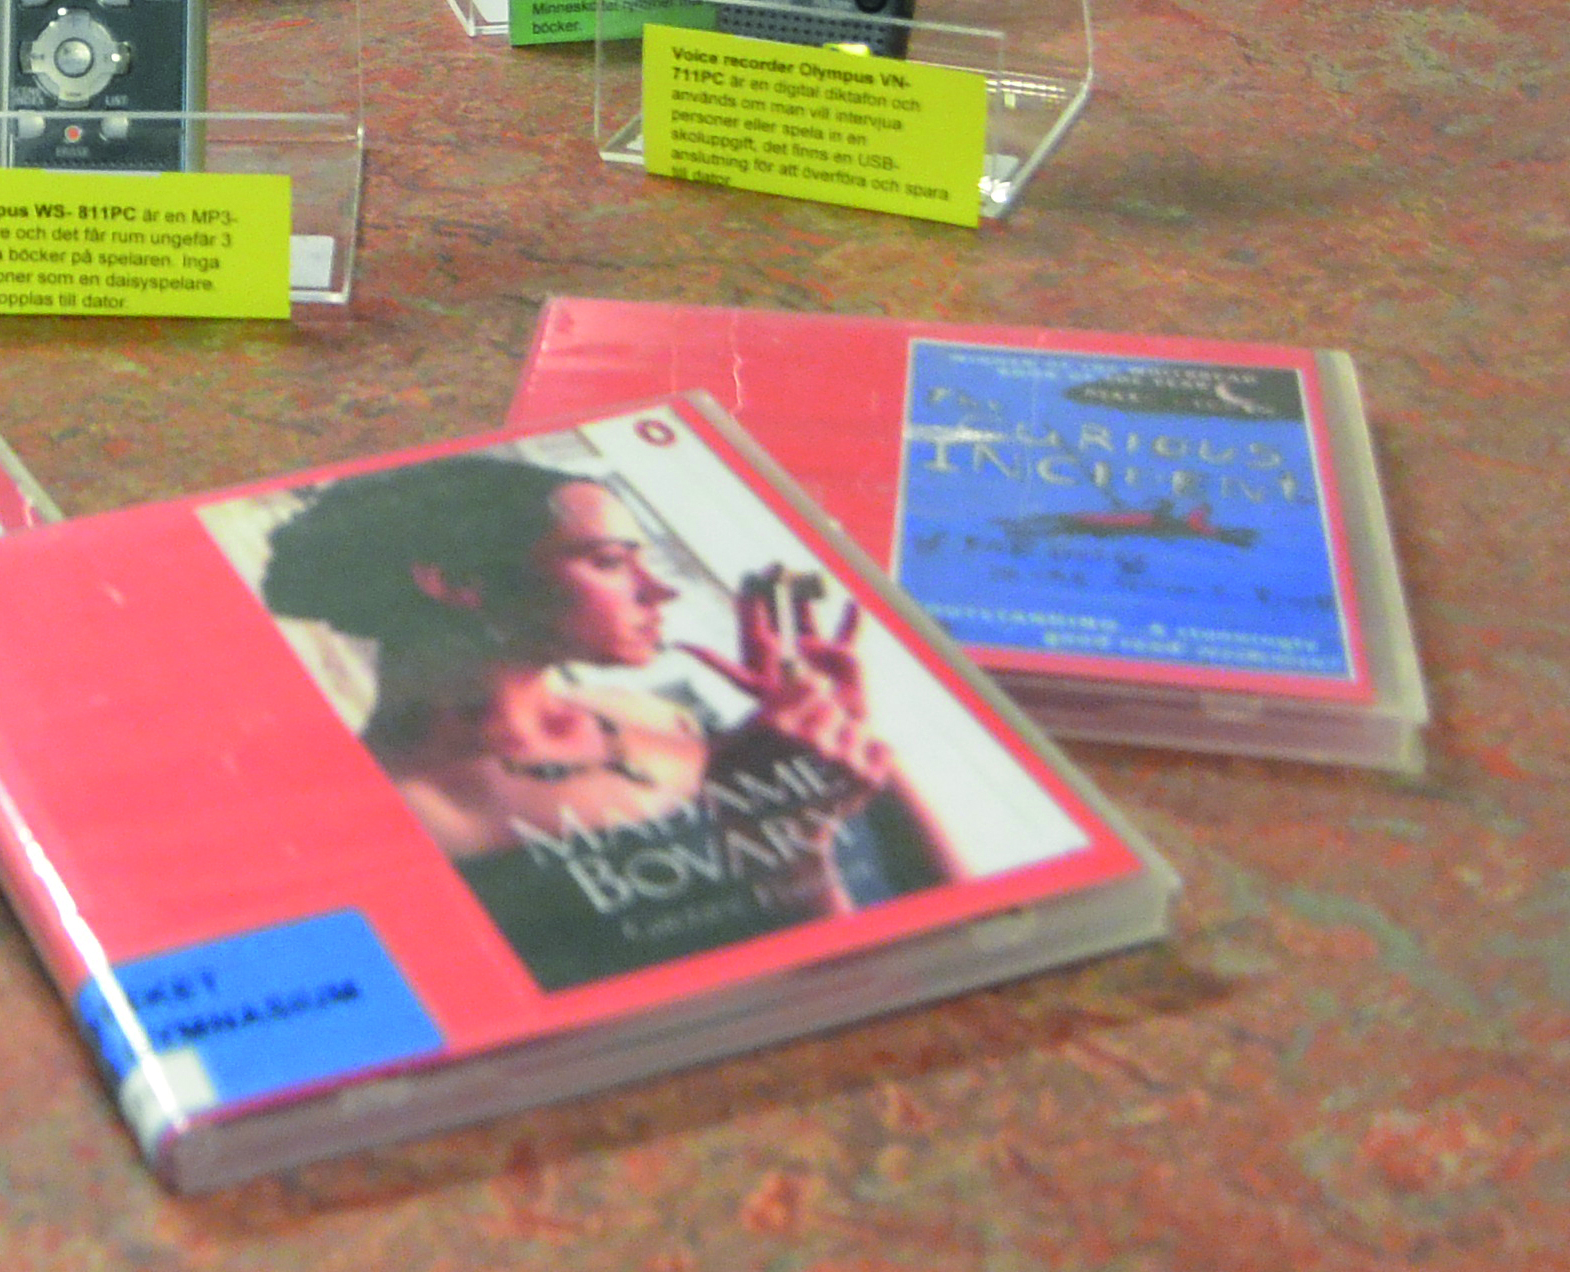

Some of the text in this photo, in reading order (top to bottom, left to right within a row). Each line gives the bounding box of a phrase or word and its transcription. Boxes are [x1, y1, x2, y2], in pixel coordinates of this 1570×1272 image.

[672, 46, 912, 89] Voice recorder Olympus VN-
[673, 66, 921, 112] 711PC en digital diktafon och
[671, 89, 903, 131] används om man vill intervjua
[671, 109, 867, 146] personer eller spela en
[762, 140, 787, 155] det
[792, 143, 829, 161] finns
[833, 152, 852, 164] en
[858, 152, 900, 171] USB-
[670, 148, 949, 201] anslutning för att överföra och spara
[34, 203, 73, 219] WS-
[78, 205, 137, 221] 811PC
[142, 209, 160, 223] är
[164, 211, 186, 224] en
[191, 208, 238, 226] MP3-
[15, 226, 47, 240] och
[51, 226, 80, 241] det
[111, 231, 145, 244] rum
[221, 231, 232, 248] 3
[8, 246, 67, 263] böcker
[70, 248, 92, 266] på
[182, 253, 221, 273] Inga
[37, 272, 74, 285] som
[78, 273, 100, 286] en
[58, 292, 77, 306] till
